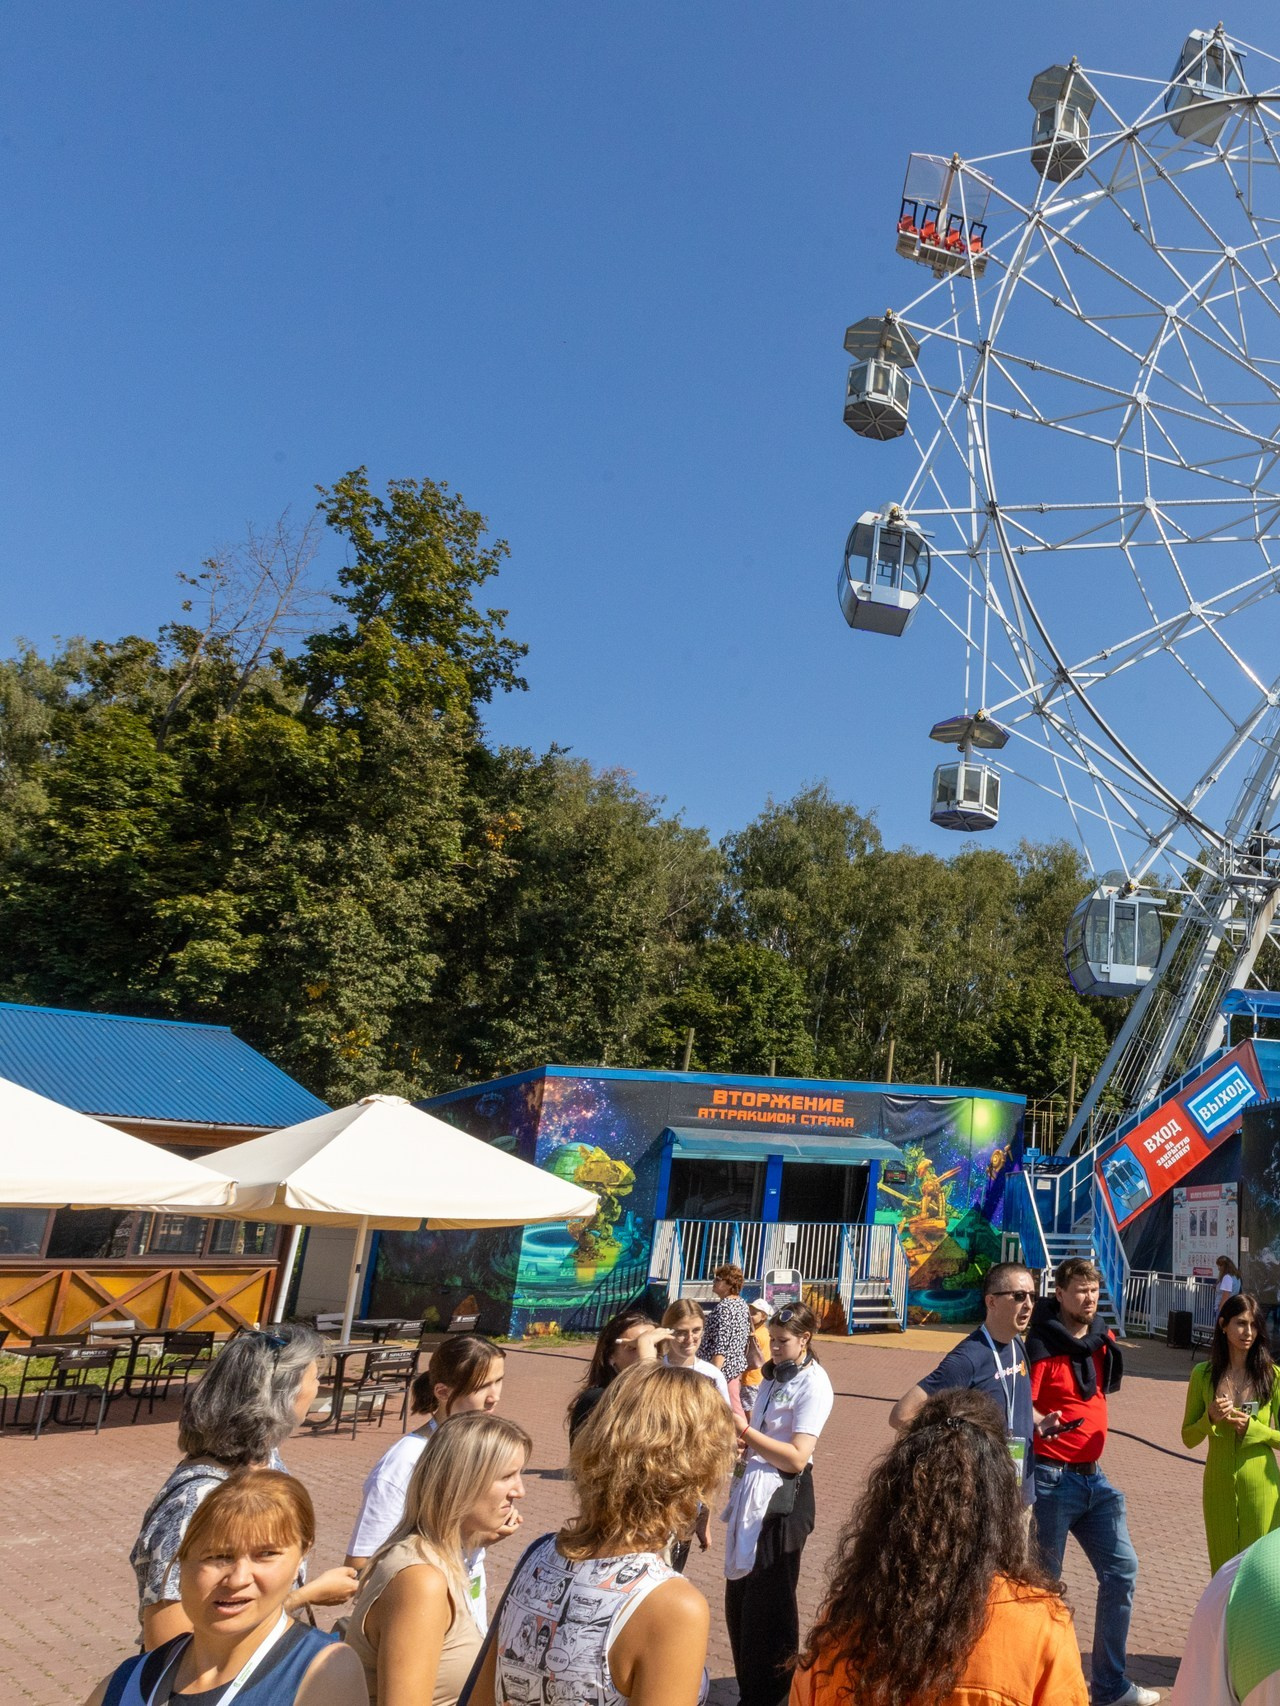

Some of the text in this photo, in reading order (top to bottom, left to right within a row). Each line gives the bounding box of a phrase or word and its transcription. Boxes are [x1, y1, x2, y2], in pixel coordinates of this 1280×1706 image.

[712, 1089, 845, 1113] ВТОРЖЕНИЕ
[1198, 1078, 1248, 1121] ВЫХОД
[698, 1107, 855, 1128] АТТРАКЦИОН СТРАХА
[1143, 1118, 1182, 1154] ВХОД
[1164, 1141, 1175, 1151] НА
[1156, 1136, 1190, 1167] ЗАКРЫТУЮ
[1163, 1144, 1190, 1169] КАБИНКУ
